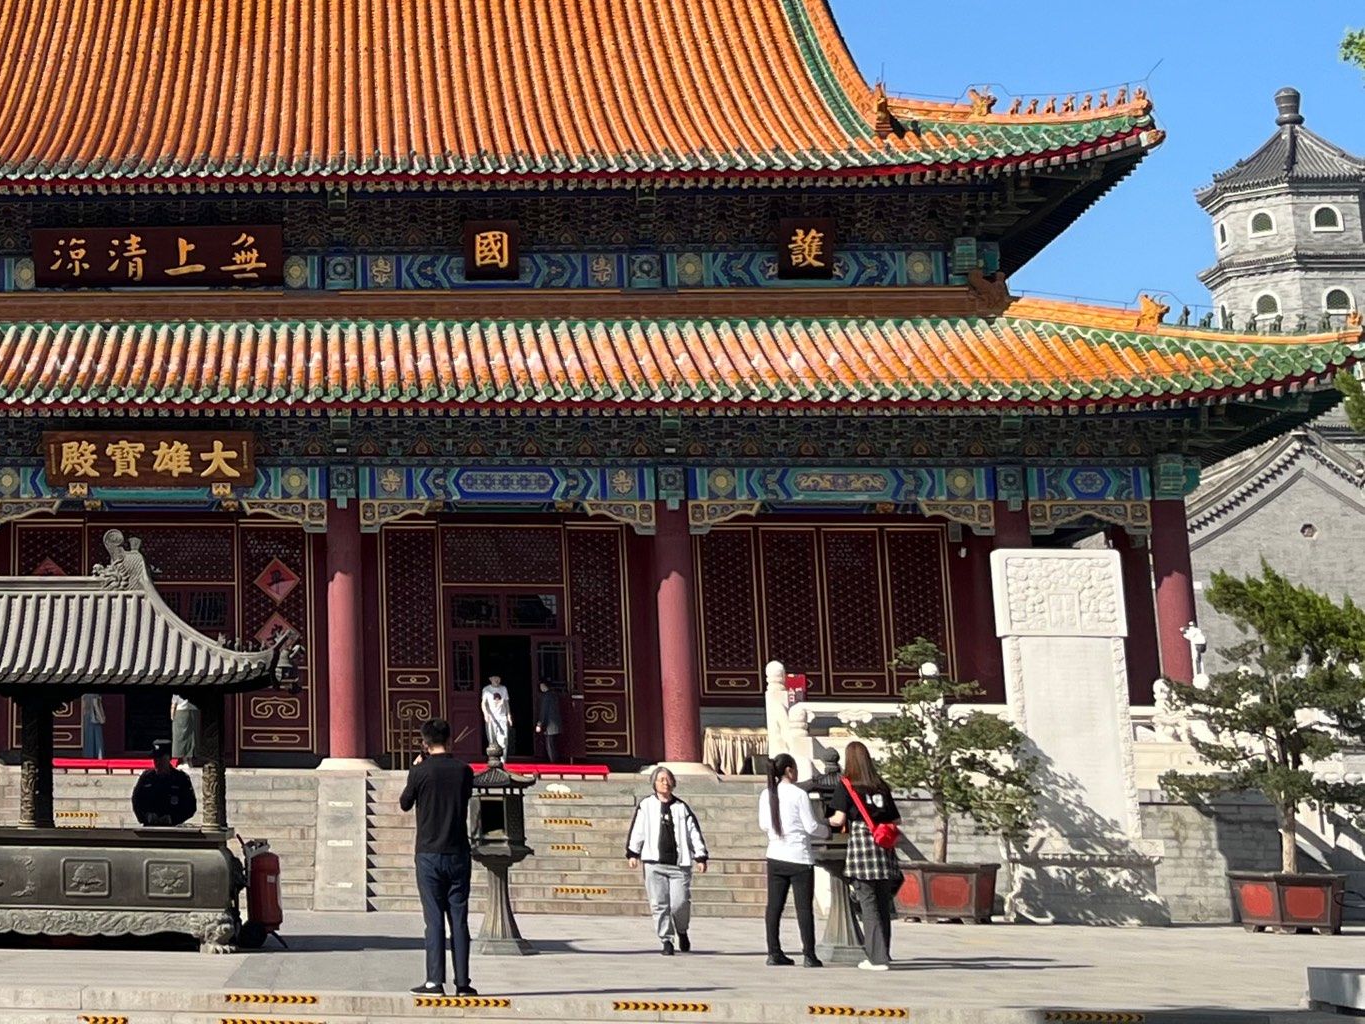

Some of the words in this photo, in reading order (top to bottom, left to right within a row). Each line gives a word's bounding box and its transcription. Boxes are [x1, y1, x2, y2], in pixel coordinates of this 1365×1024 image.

[476, 231, 508, 268] 國
[788, 228, 825, 267] 護
[60, 440, 240, 477] 大雄寶殿
